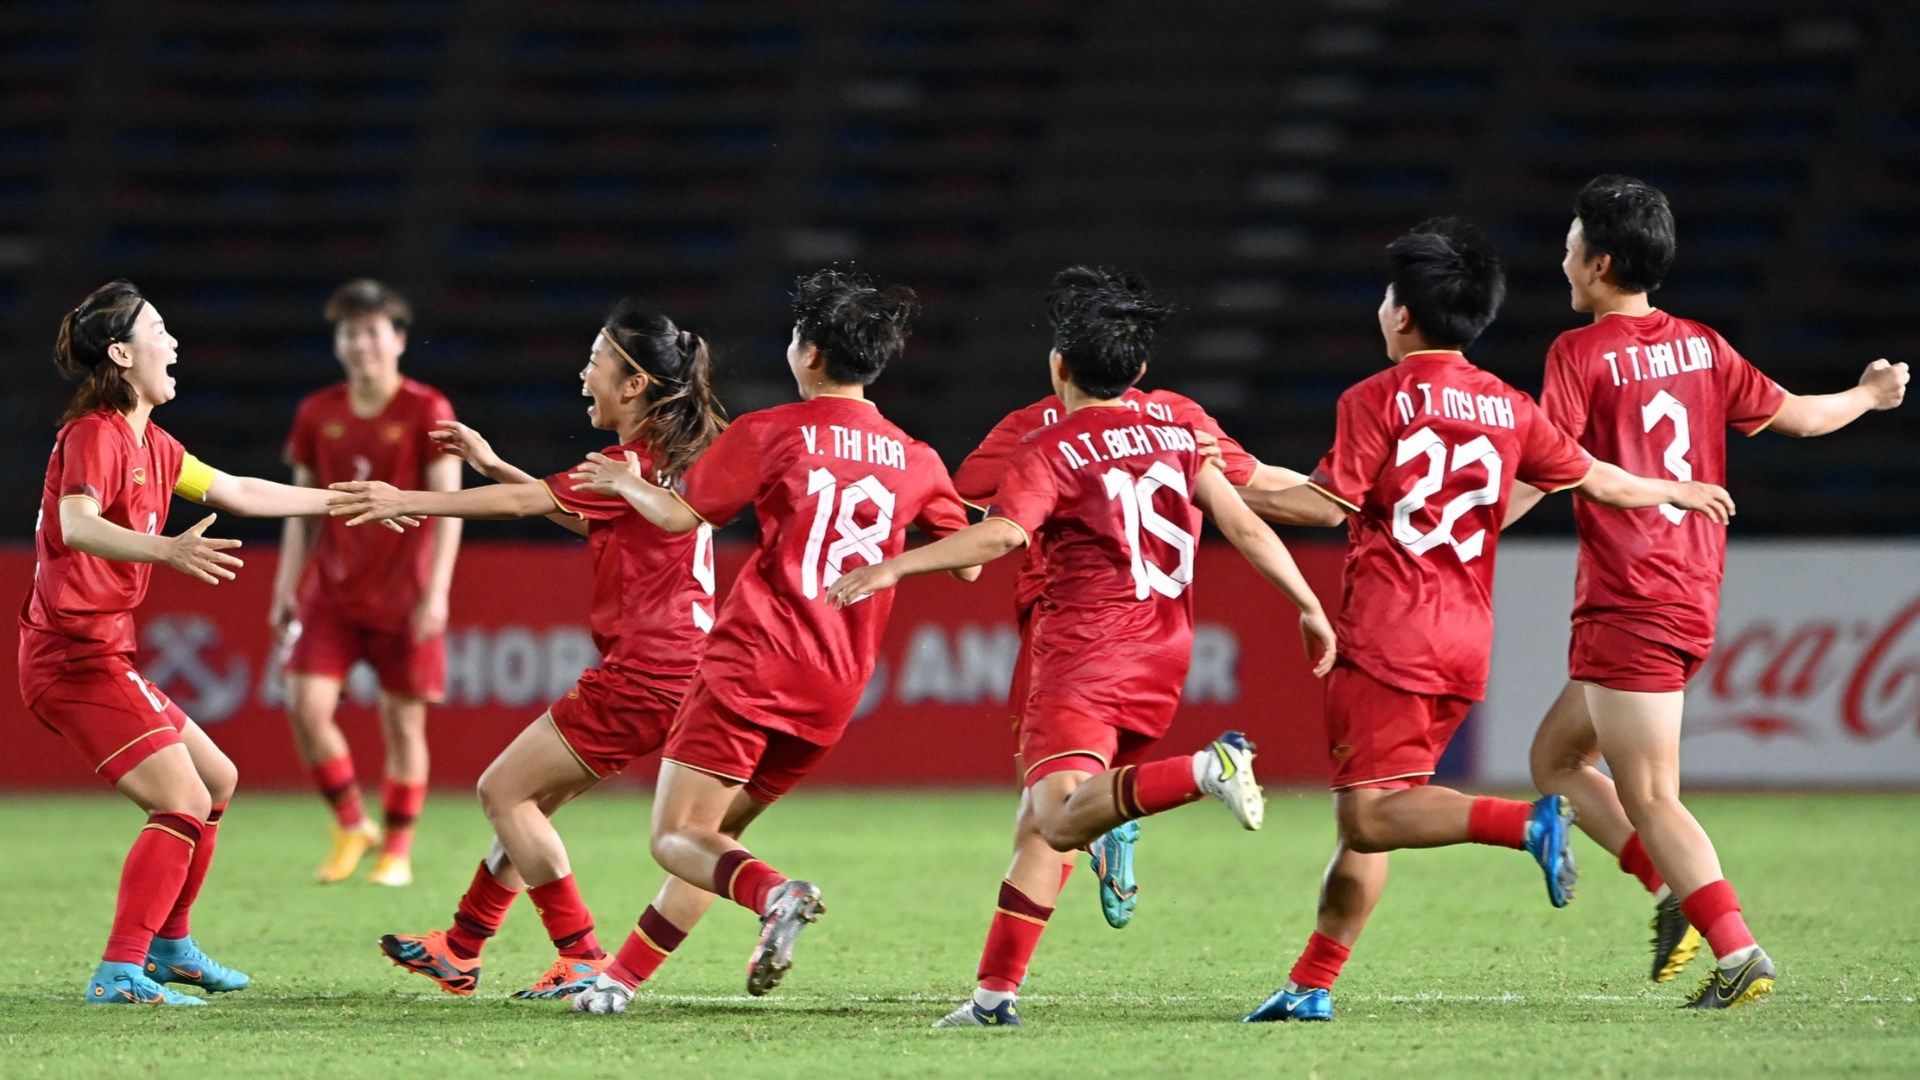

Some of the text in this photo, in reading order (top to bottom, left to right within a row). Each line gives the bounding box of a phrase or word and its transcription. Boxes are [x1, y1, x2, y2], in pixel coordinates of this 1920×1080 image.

[1417, 383, 1440, 416] T.
[1442, 387, 1476, 421] MY
[1476, 394, 1515, 429] ANH
[1603, 351, 1629, 386] T.
[1676, 336, 1712, 372] LINH
[801, 425, 906, 470] V. THI HOA
[1102, 424, 1153, 459] BICH
[1642, 390, 1692, 525] 3
[802, 467, 896, 604] 18
[1101, 461, 1194, 600] 15
[1393, 427, 1502, 562] 22
